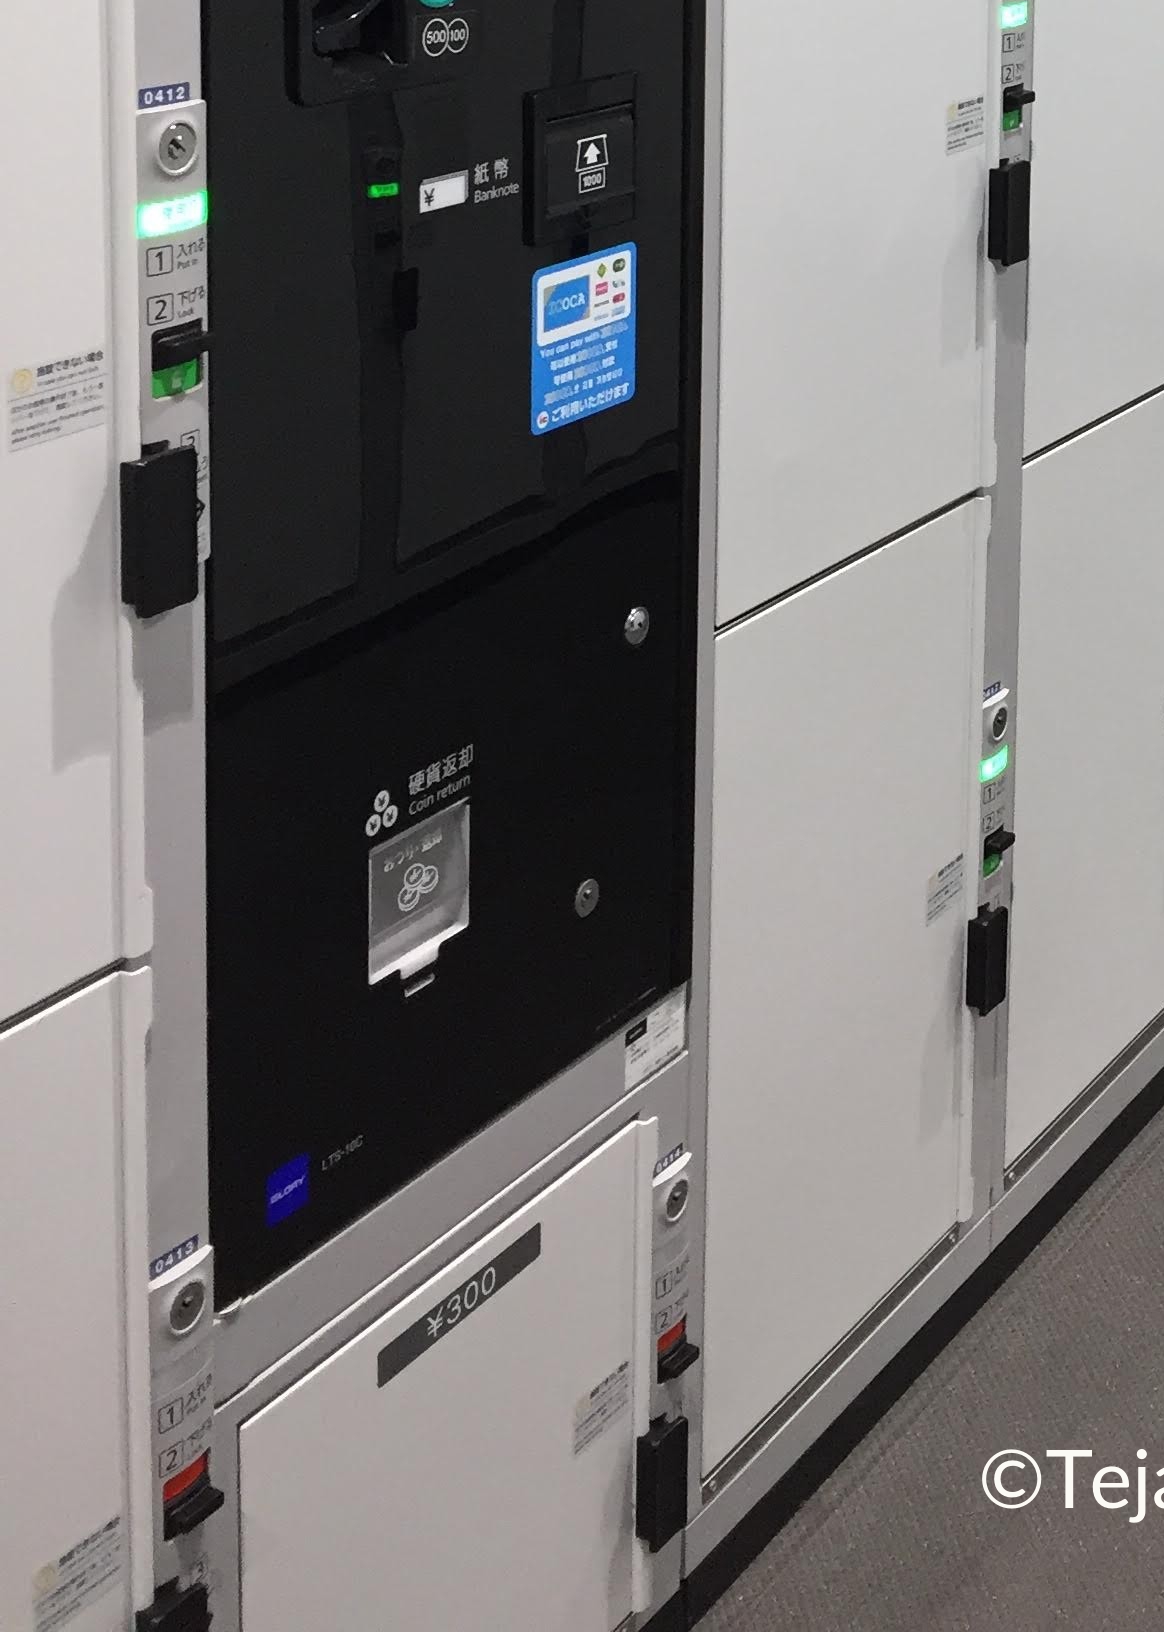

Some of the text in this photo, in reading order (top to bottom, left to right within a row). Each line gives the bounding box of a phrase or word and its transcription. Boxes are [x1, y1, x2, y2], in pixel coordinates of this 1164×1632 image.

[426, 28, 466, 45] 500 100
[144, 85, 187, 104] 0412
[474, 182, 521, 205] Banknote
[582, 173, 603, 189] 1000
[155, 237, 206, 273] 1 入れる
[154, 285, 206, 322] 2 下げる
[408, 743, 474, 796] 硬貨返却
[408, 774, 471, 816] Coin return
[154, 1239, 196, 1275] 0413
[427, 1266, 497, 1338] ¥300
[165, 1450, 178, 1474] 2
